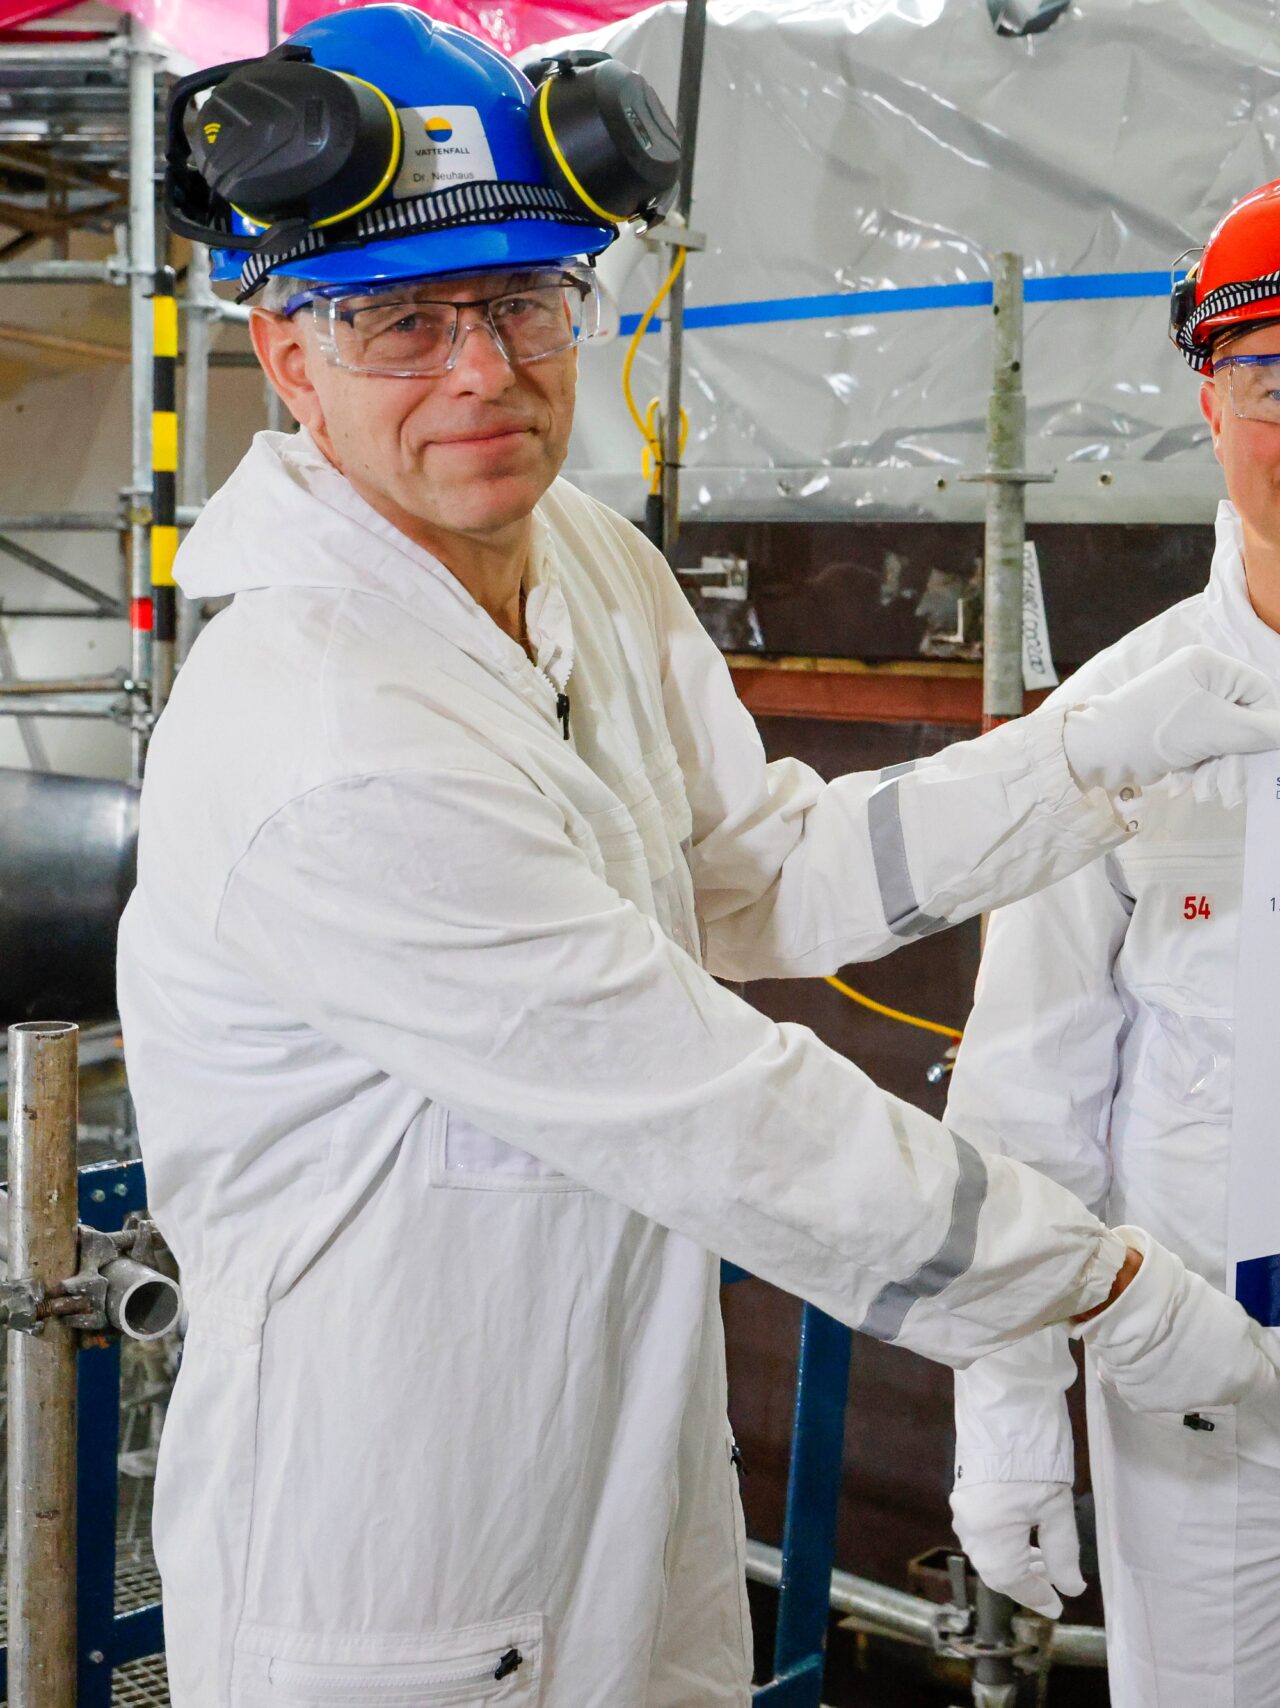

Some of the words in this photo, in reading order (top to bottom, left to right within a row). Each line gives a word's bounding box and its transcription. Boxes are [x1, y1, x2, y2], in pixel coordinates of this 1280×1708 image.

[415, 147, 470, 156] VATTENFALL
[431, 172, 474, 181] Neuhaus
[1183, 896, 1211, 920] 54
